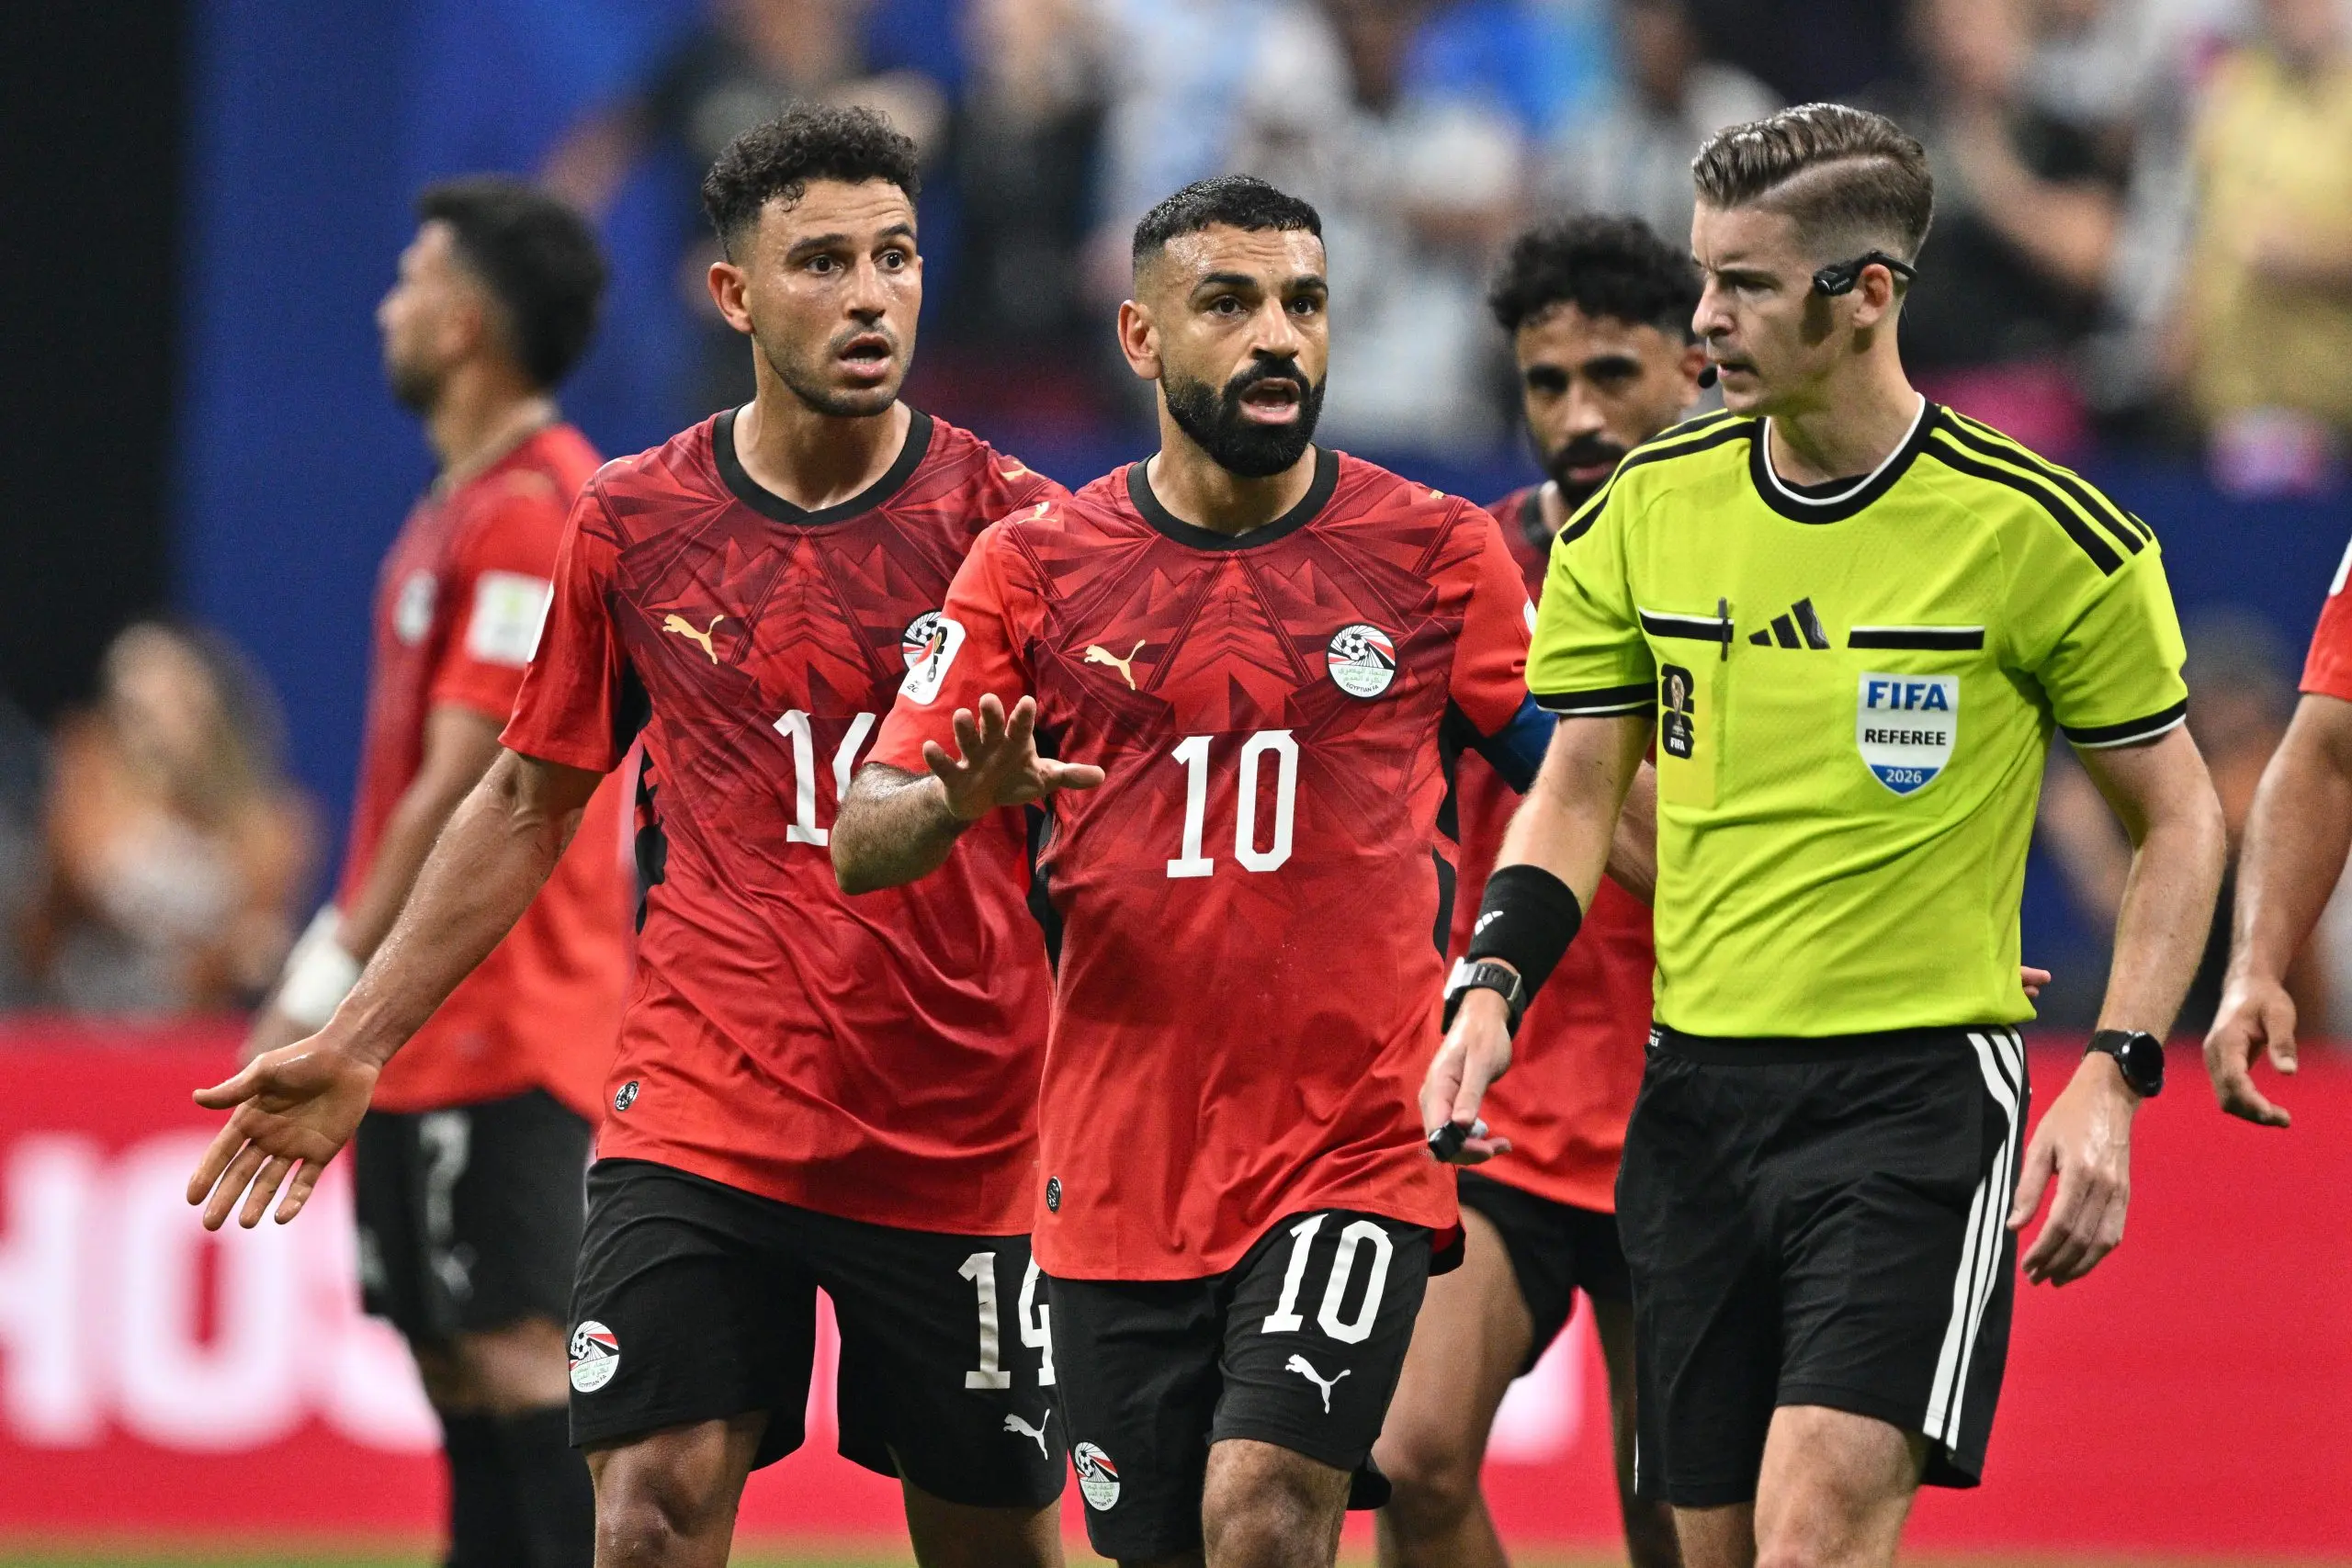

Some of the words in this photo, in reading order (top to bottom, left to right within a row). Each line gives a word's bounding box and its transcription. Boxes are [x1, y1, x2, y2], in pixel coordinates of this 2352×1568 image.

[1345, 682, 1372, 693] EGYPTIAN
[1867, 681, 1949, 711] FIFA
[1670, 737, 1685, 751] FIFA
[1864, 728, 1946, 745] REFEREE
[1886, 769, 1922, 784] 2026
[1167, 729, 1299, 878] 10
[1261, 1213, 1393, 1345] 10
[957, 1252, 1056, 1389] 14
